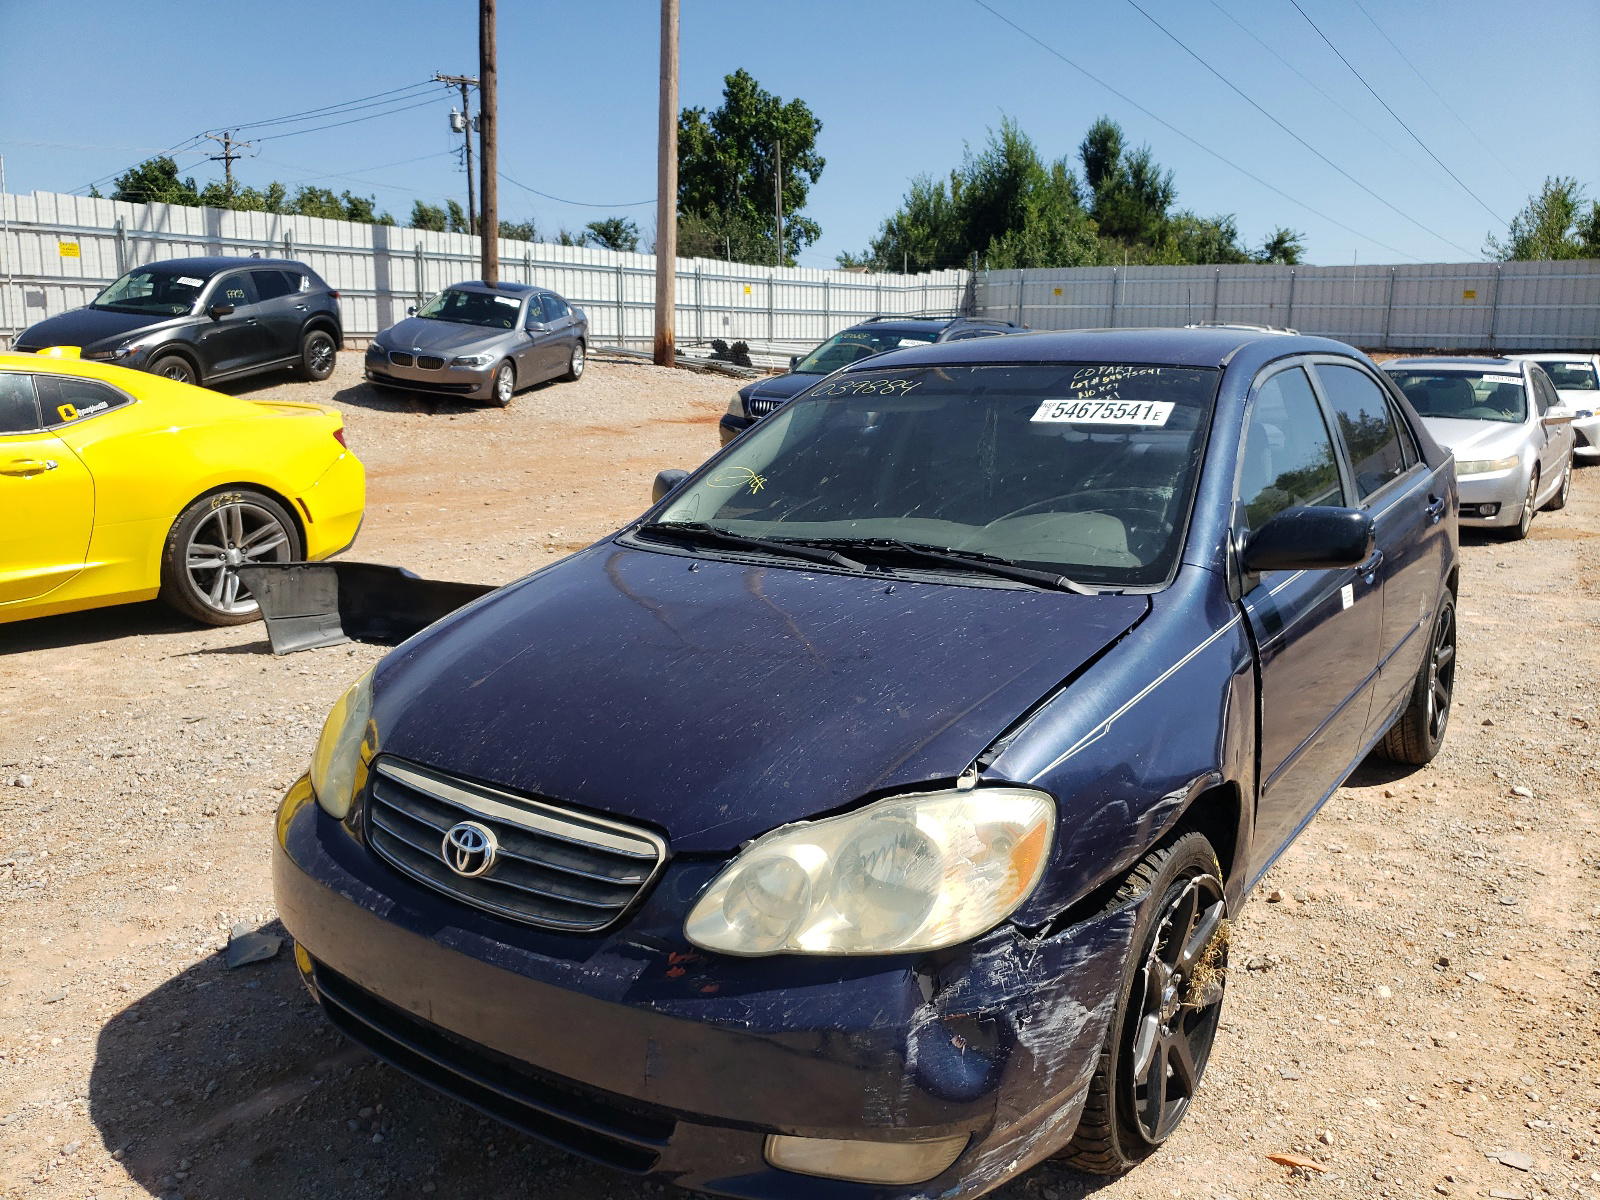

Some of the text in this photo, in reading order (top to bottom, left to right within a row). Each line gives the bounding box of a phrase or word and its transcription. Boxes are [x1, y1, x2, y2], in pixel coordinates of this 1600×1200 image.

[1078, 389, 1096, 399] NO
[1051, 402, 1154, 420] 54675541
[1152, 411, 1163, 421] E
